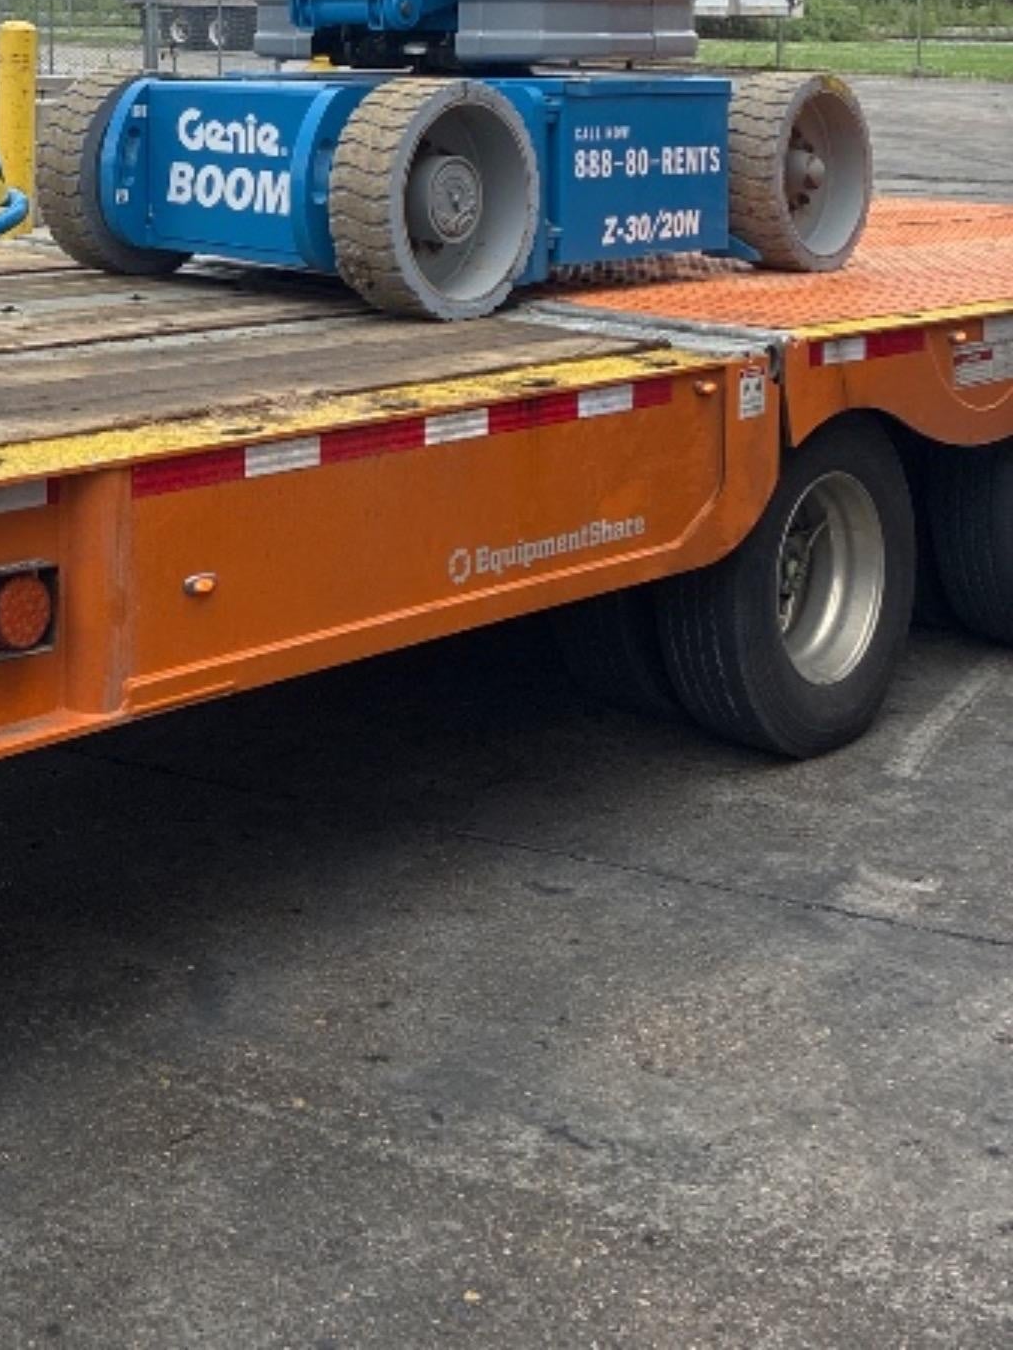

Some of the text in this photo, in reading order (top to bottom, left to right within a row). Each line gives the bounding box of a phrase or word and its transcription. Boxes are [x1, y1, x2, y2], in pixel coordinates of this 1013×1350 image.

[574, 125, 601, 141] CALL
[574, 145, 721, 179] 888-80-RENTS
[166, 161, 291, 217] BOOM
[601, 209, 701, 246] Z-30/20N
[475, 515, 646, 576] EquipmentShare
